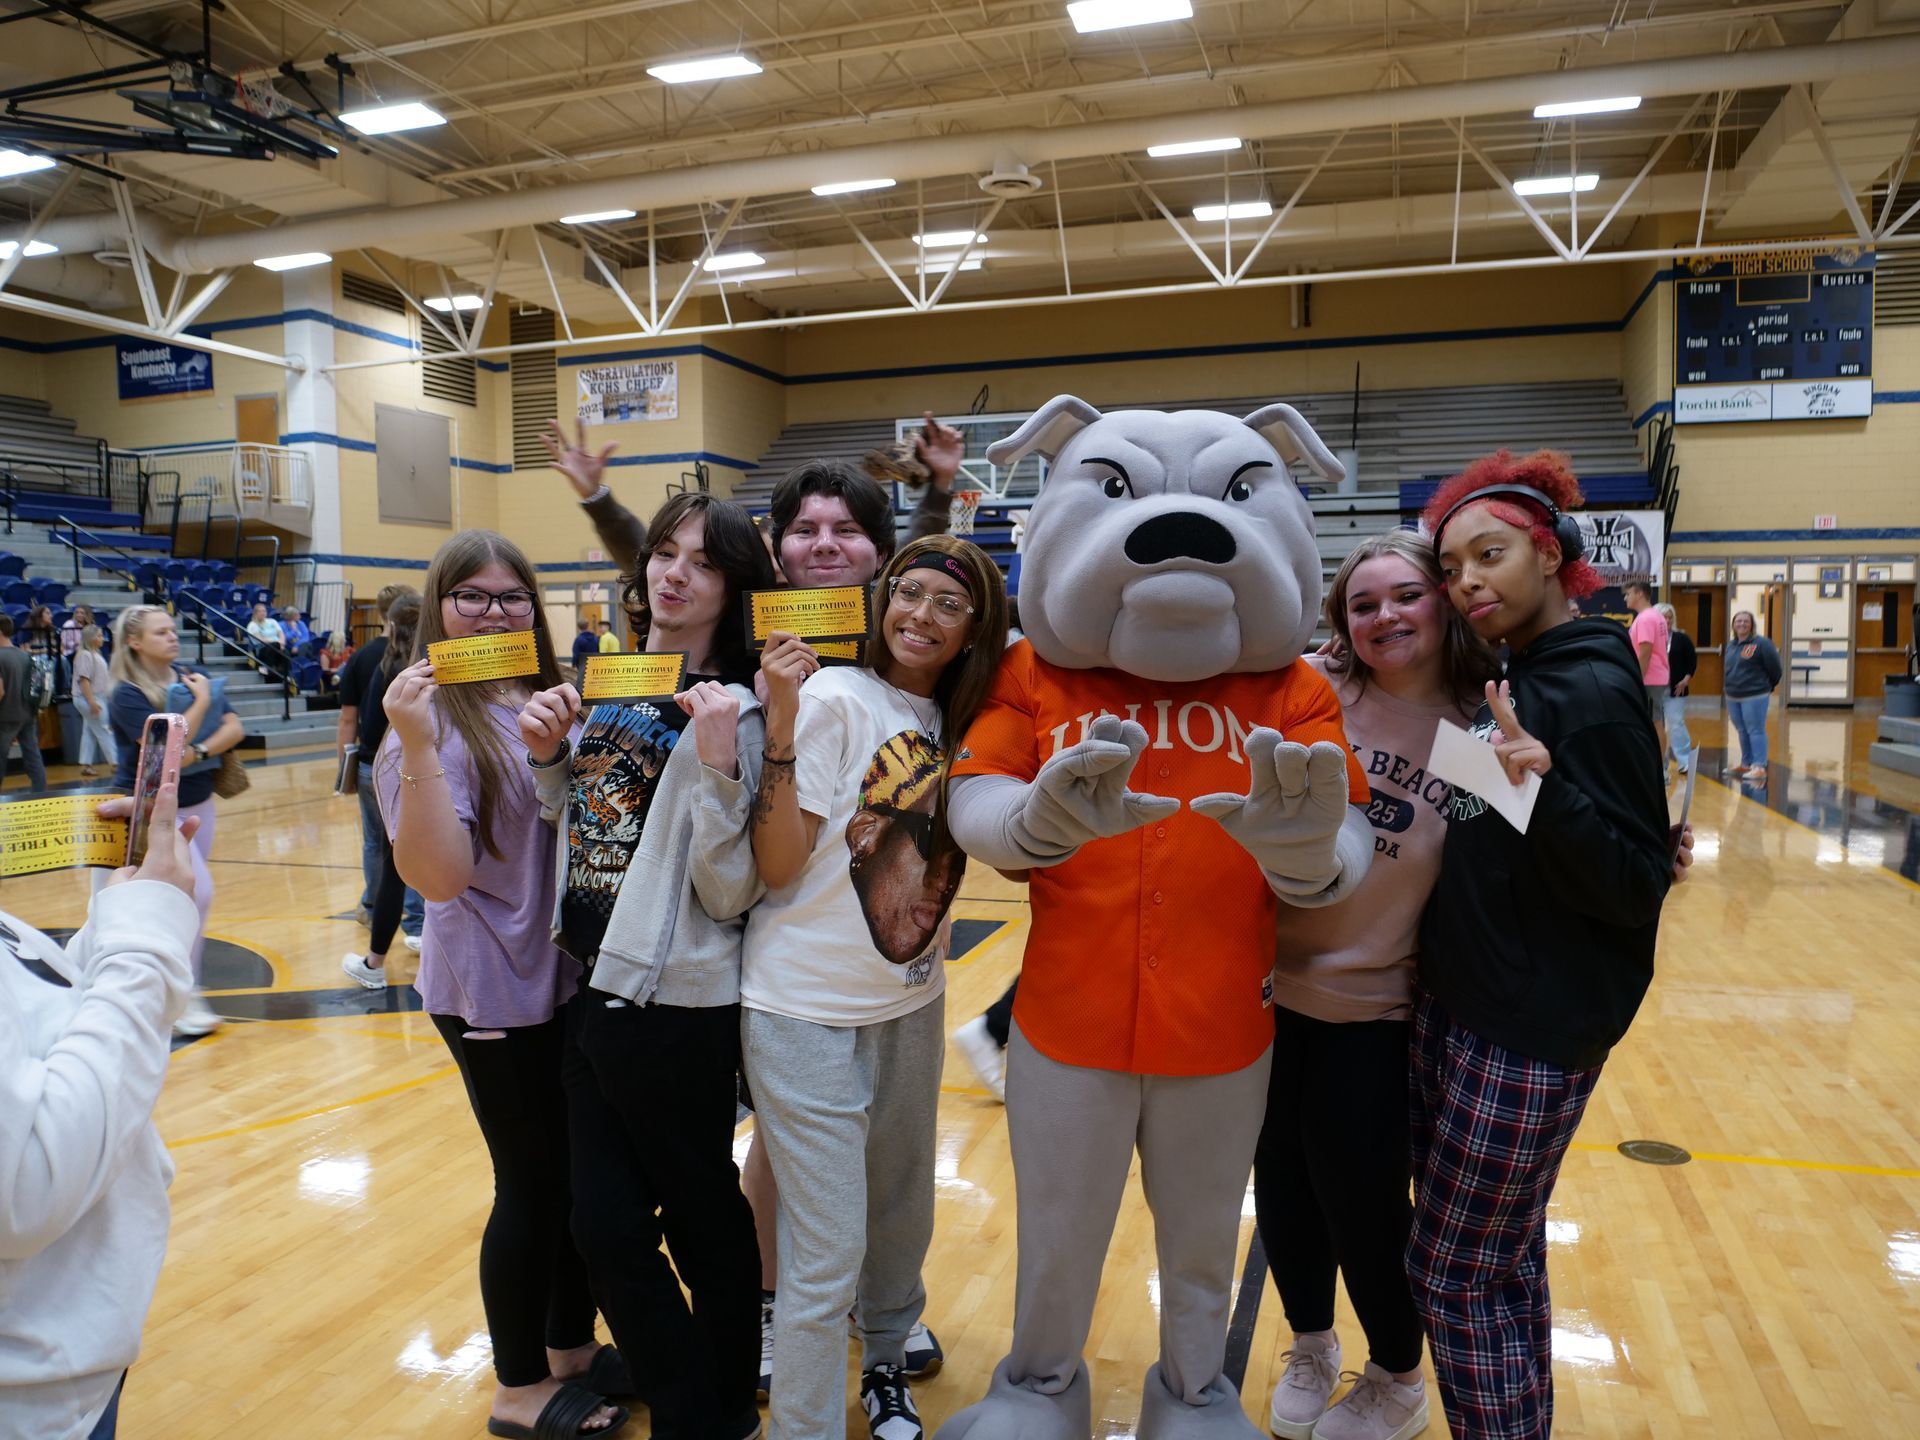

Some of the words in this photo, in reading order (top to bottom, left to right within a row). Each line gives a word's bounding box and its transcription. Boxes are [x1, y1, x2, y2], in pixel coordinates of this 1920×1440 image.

[1733, 258, 1762, 275] HIGH
[1766, 255, 1816, 273] SCHOOL
[1690, 282, 1721, 294] Home
[1758, 312, 1789, 328] period
[1757, 331, 1788, 346] player
[120, 346, 171, 366] Southeast
[131, 361, 177, 380] Kentucky
[1688, 371, 1707, 382] won
[1760, 367, 1785, 380] game
[1840, 363, 1860, 375] won
[590, 380, 620, 395] KCHS
[1679, 398, 1717, 411] Forcht
[1720, 397, 1753, 409] Bank
[1818, 517, 1832, 528] EXIT
[1583, 532, 1630, 549] INGHAM
[819, 601, 857, 610] PATHWAY
[493, 644, 529, 655] PATHWAY
[1050, 700, 1261, 765] UION
[609, 707, 680, 778] VIBES
[1367, 750, 1452, 820] BEACH
[590, 844, 628, 867] Guts
[591, 868, 625, 894] ory
